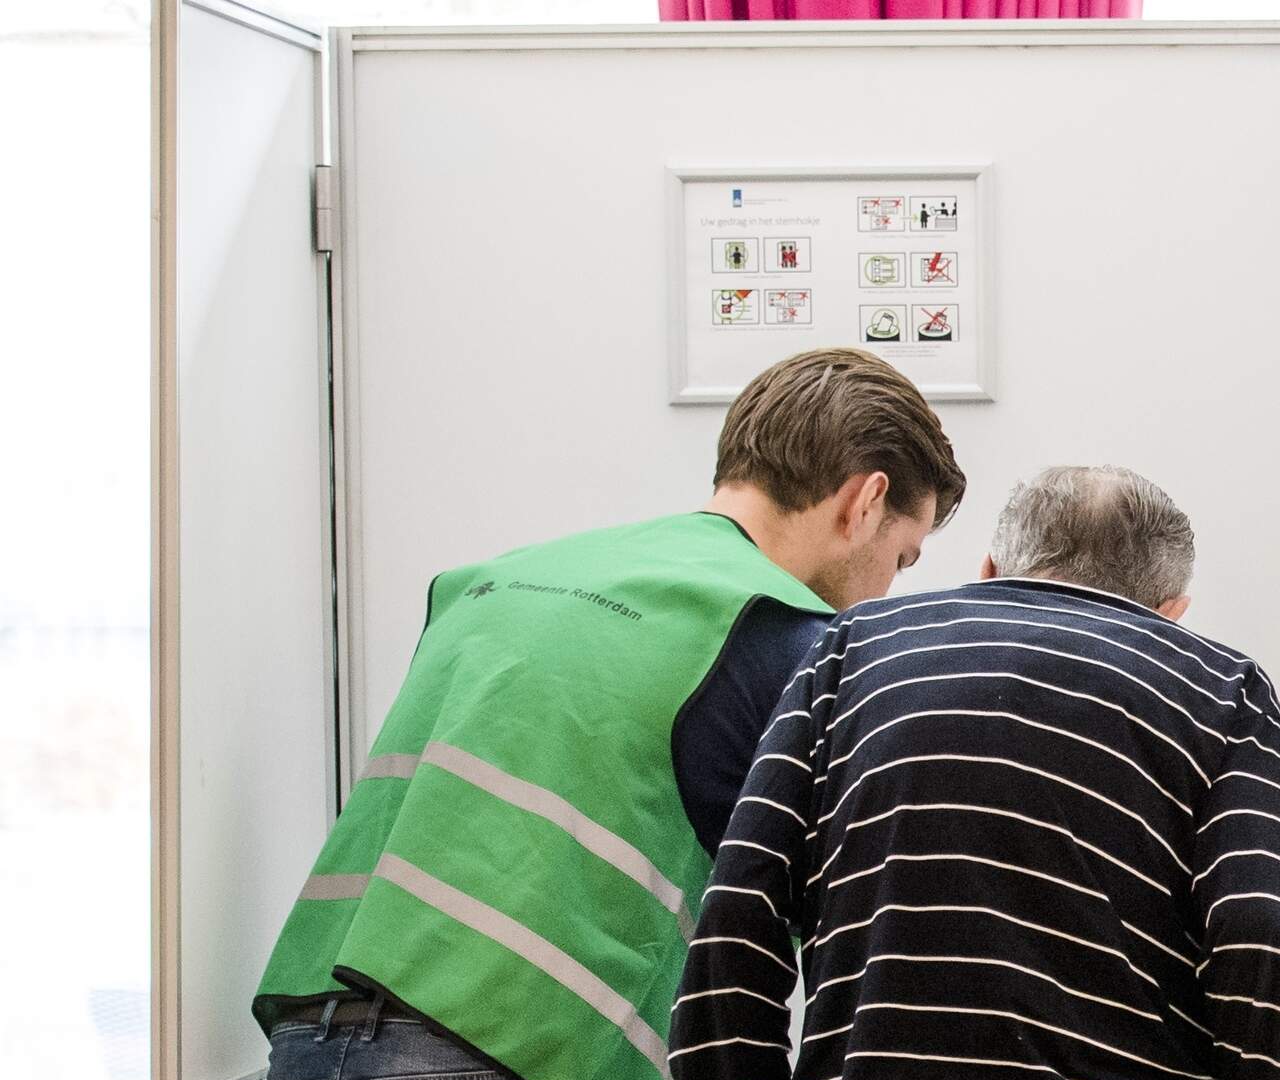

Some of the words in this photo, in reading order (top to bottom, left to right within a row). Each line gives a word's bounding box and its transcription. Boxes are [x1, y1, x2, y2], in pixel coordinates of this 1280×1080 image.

[700, 217, 715, 227] Uw
[717, 217, 747, 229] gedrag
[748, 217, 757, 226] in
[758, 217, 773, 226] het
[774, 216, 821, 228] stemhokje
[507, 580, 567, 595] Gemeente
[569, 587, 643, 622] Rotterdam
